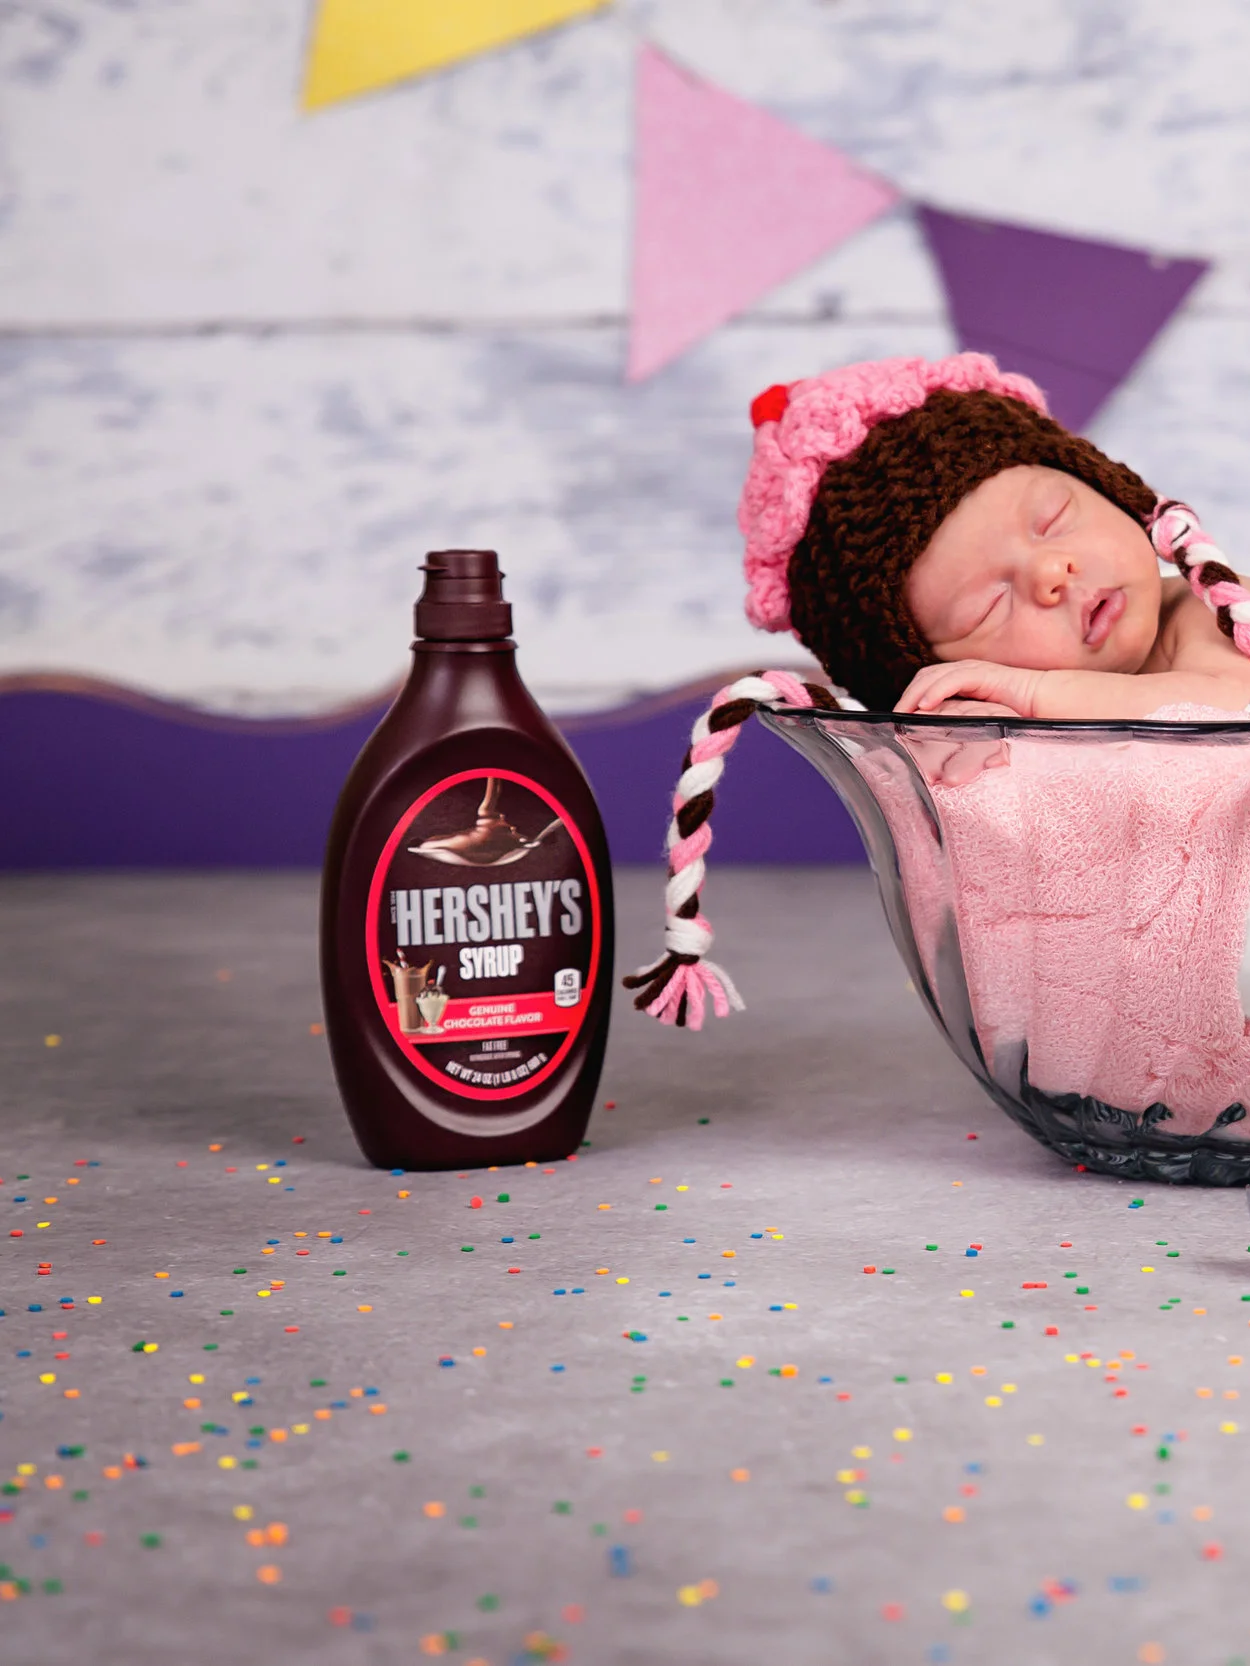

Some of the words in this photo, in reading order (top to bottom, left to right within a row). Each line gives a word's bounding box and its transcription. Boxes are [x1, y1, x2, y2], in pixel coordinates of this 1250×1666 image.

[396, 878, 582, 946] HERSHEY'S
[459, 944, 524, 980] SYRUP
[443, 1015, 504, 1029] CHOCOLATE
[504, 1012, 543, 1025] FLAVOR
[469, 1003, 516, 1016] GENUINE
